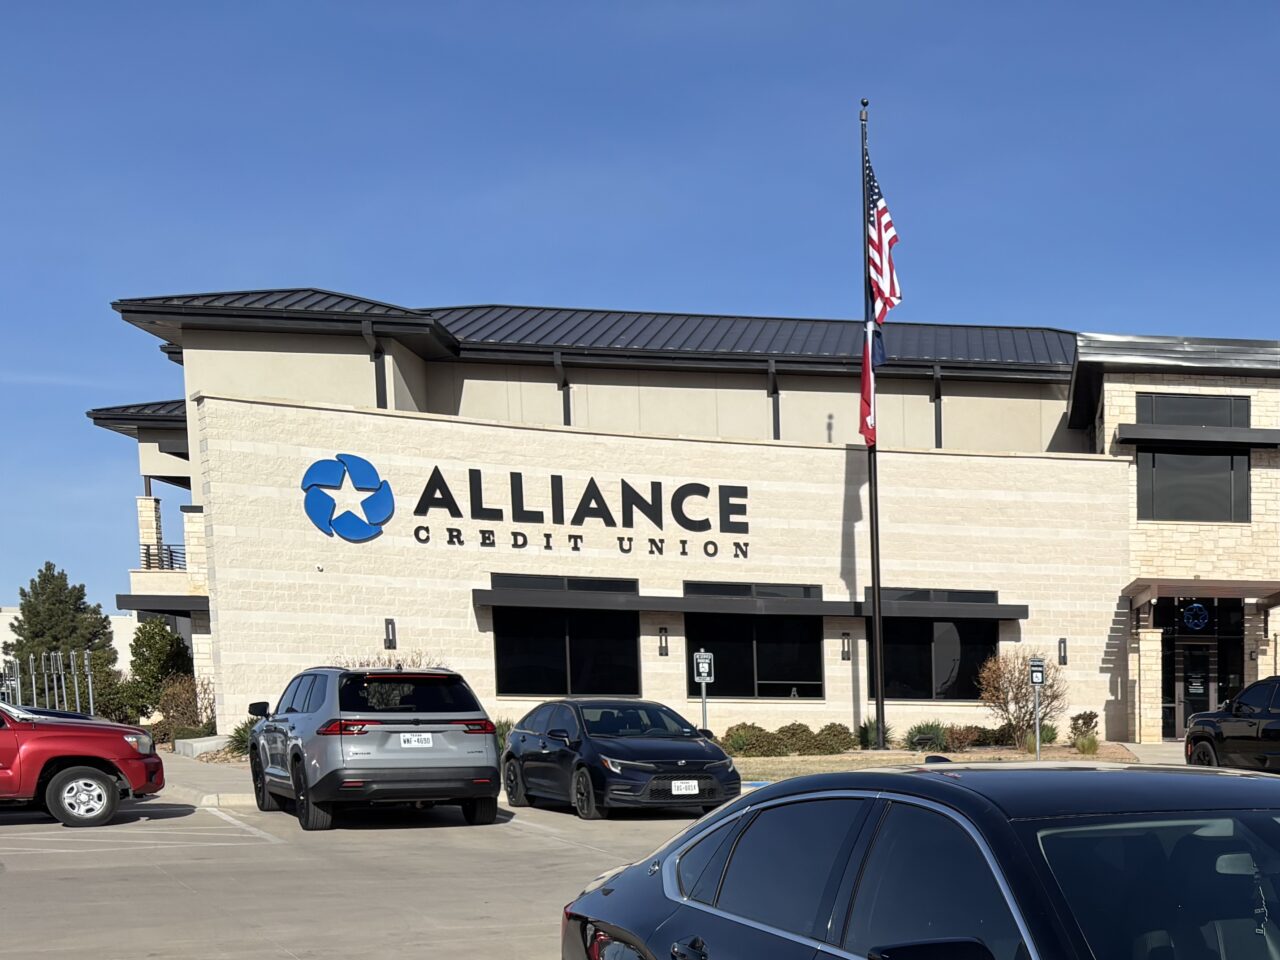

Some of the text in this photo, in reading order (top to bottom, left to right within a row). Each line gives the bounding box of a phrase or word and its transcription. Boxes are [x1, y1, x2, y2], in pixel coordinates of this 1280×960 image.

[413, 465, 750, 535] ALLIANCE
[413, 525, 750, 559] CREDIT UNION
